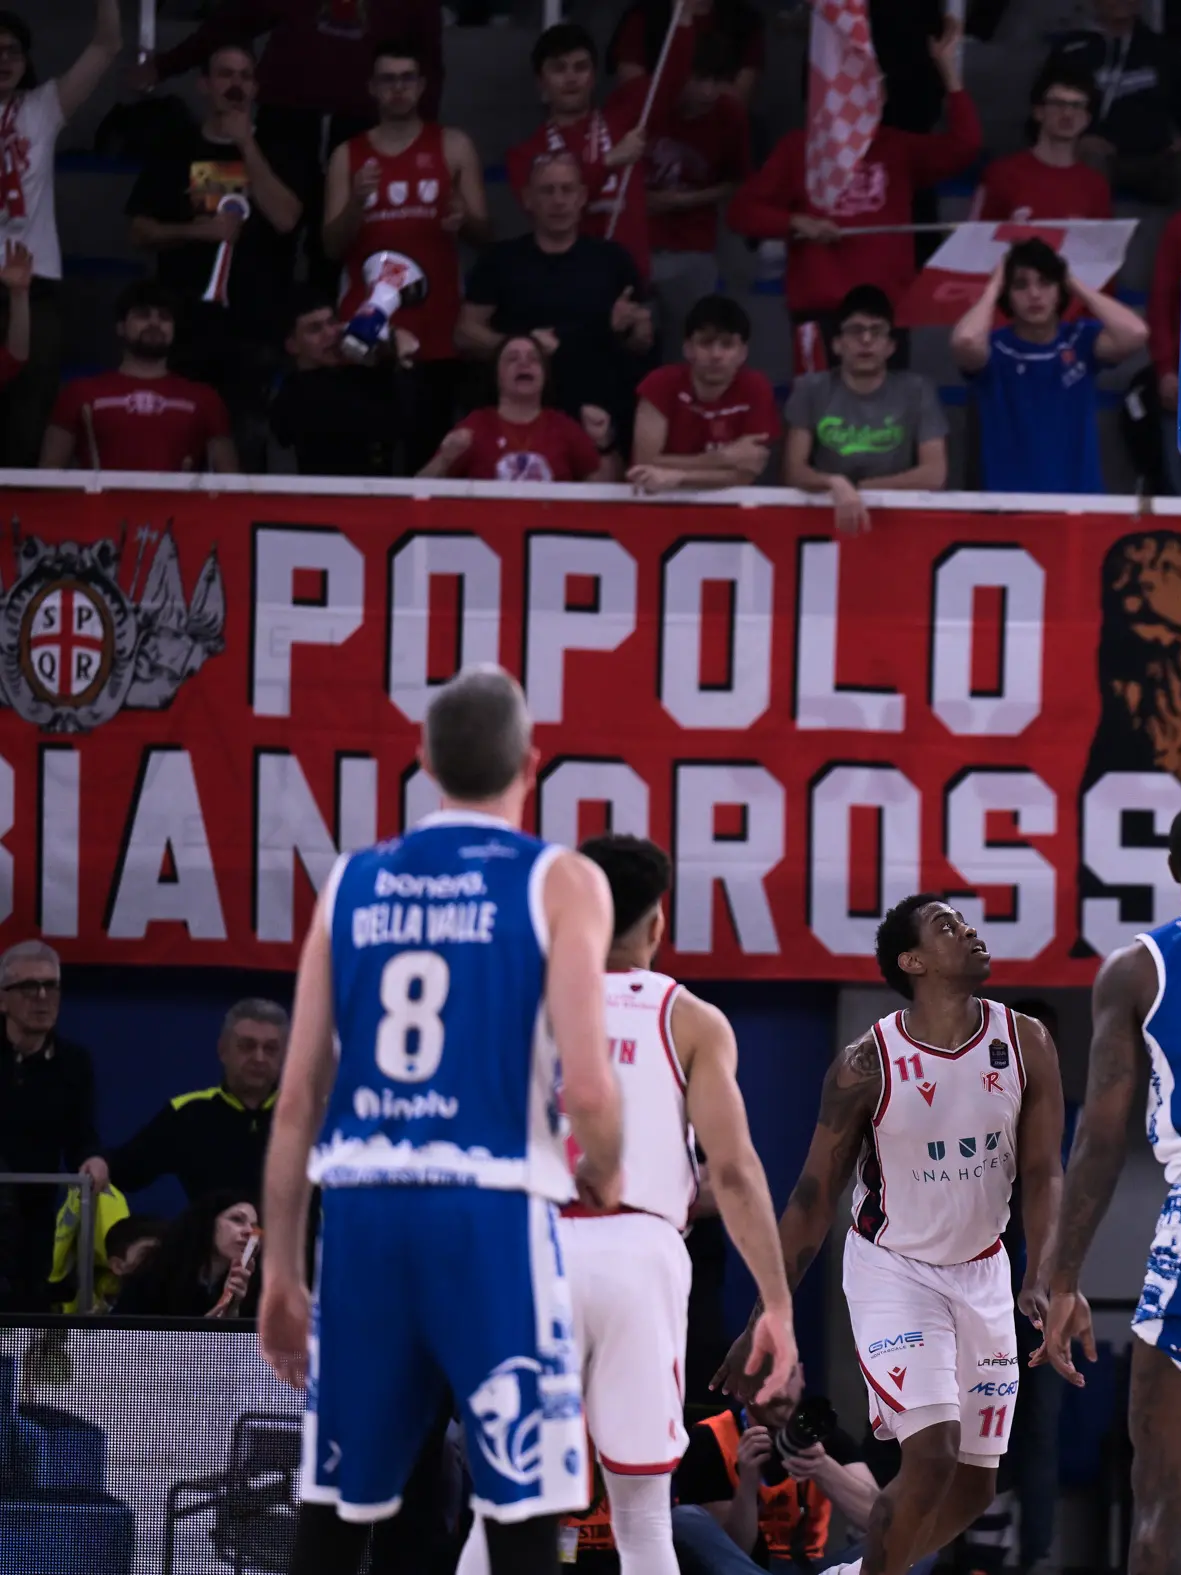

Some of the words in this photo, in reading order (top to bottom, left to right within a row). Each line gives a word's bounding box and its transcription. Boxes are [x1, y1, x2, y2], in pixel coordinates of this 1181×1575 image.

[251, 523, 1046, 737] POPOLO
[352, 901, 423, 949] DELLA
[426, 900, 498, 945] VALLE
[375, 950, 451, 1083] 8
[893, 1053, 924, 1083] 11
[869, 1331, 924, 1354] GME
[979, 1404, 1008, 1438] 11
